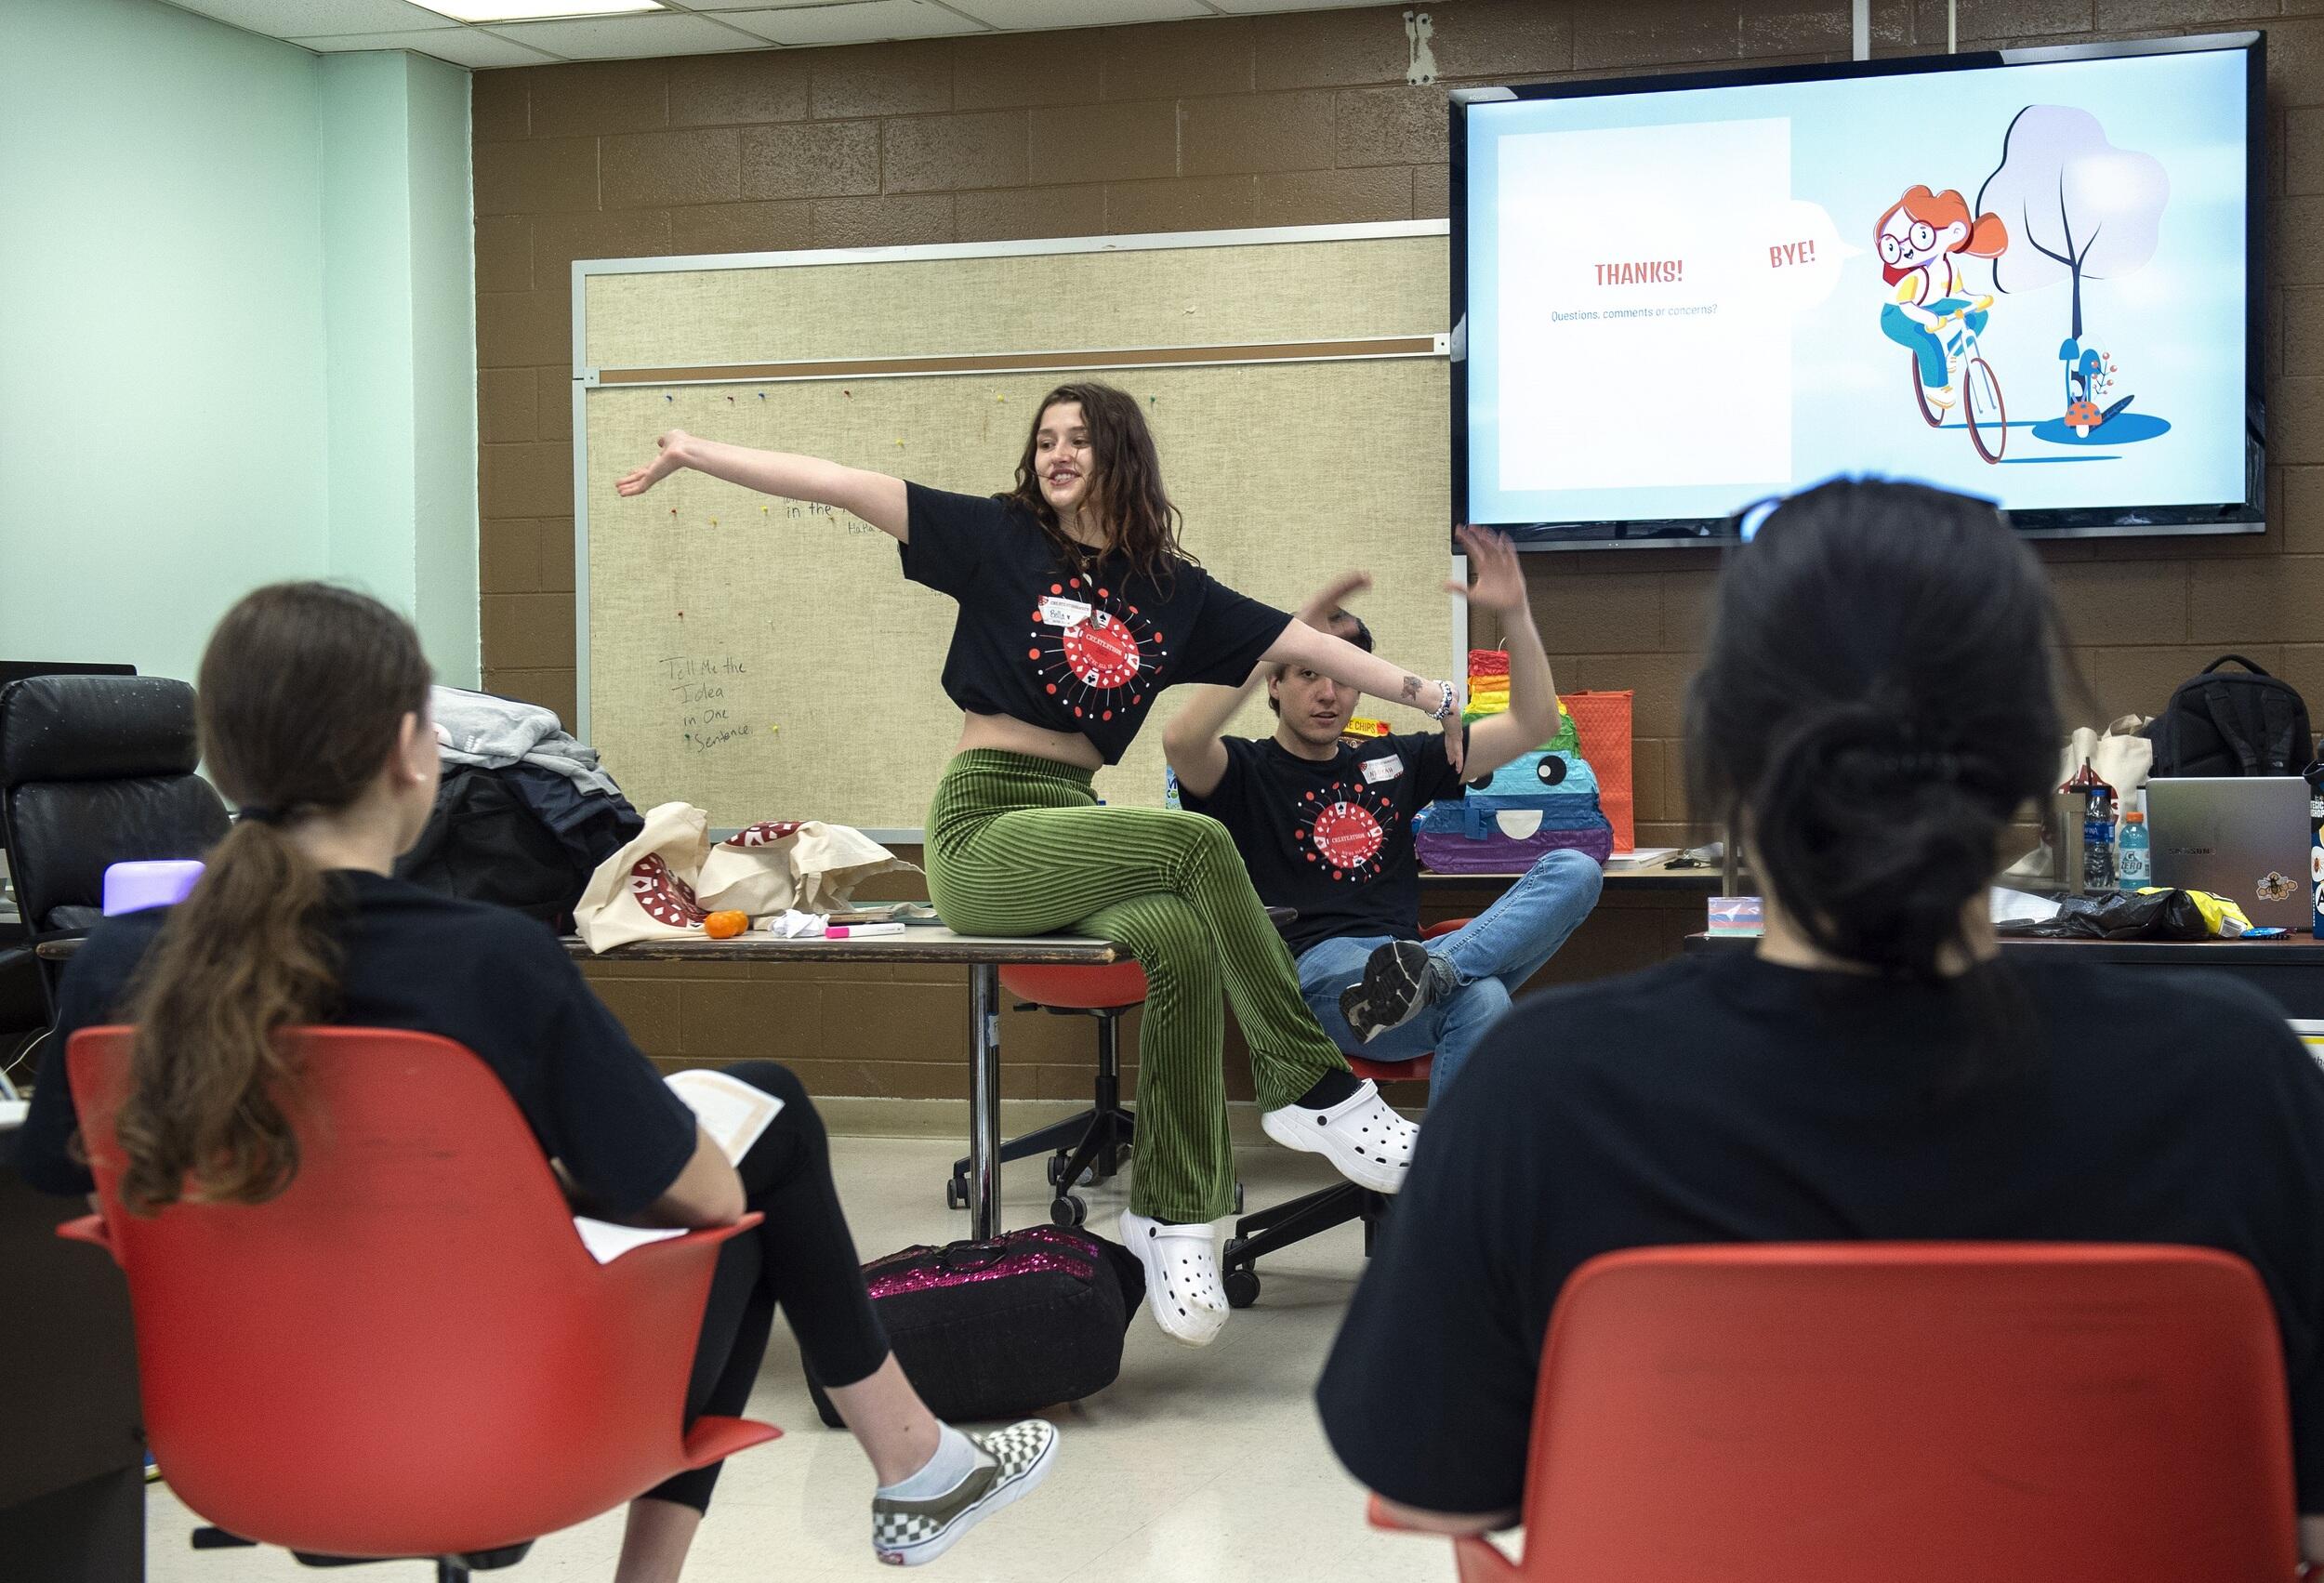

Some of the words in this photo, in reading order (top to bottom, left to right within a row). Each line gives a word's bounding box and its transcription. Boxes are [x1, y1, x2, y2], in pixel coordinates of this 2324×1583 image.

[1769, 239, 1816, 269] BYE!
[1594, 259, 1684, 285] THANKS!
[1603, 308, 1654, 319] comments
[1656, 308, 1665, 317] or
[1668, 303, 1718, 316] concerns?
[786, 506, 800, 519] in
[809, 501, 831, 516] the
[659, 656, 695, 679] Tell
[701, 659, 718, 676] Me
[723, 656, 746, 674] the
[671, 681, 724, 704] Idea
[683, 717, 697, 726] in
[704, 709, 730, 724] One
[1354, 721, 1376, 734] CHIPS
[2121, 861, 2143, 870] ZERO
